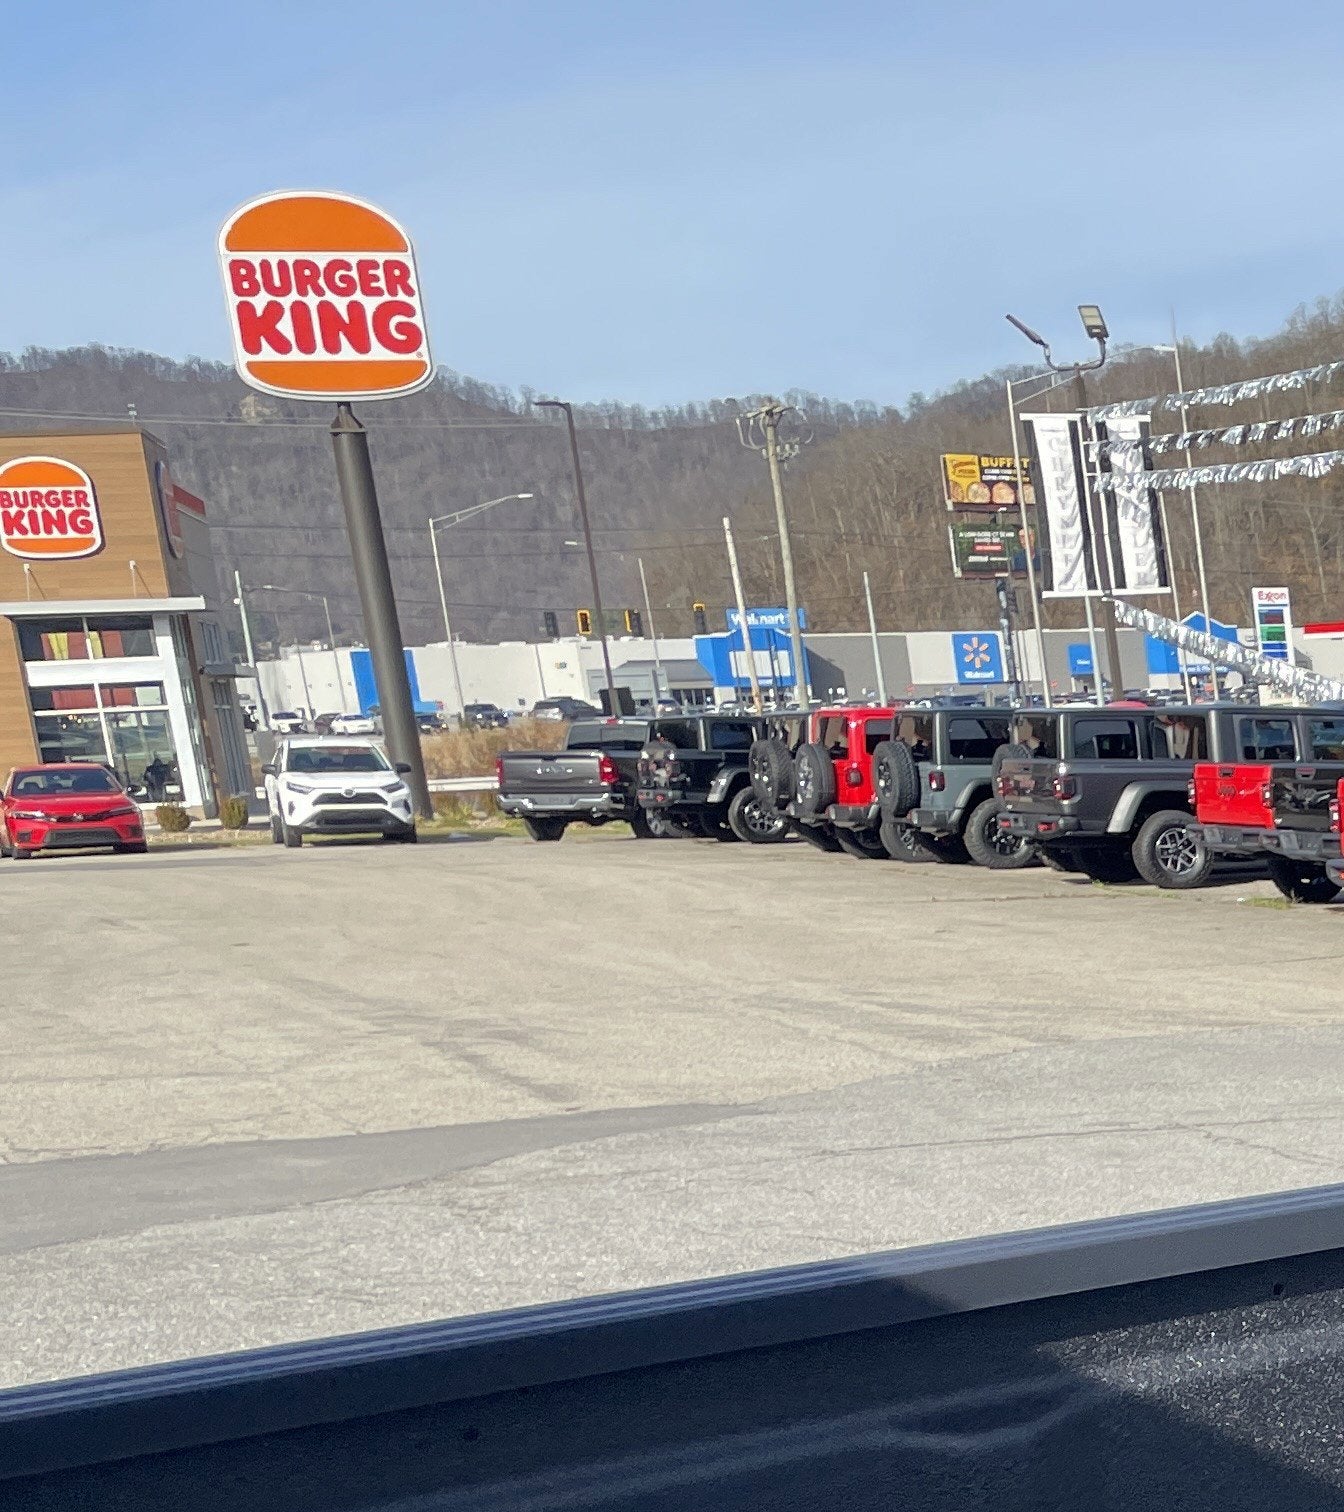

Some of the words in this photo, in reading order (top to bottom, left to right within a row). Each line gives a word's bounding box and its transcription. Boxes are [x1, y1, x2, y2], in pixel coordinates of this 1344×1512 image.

[229, 258, 416, 298] BURGER
[236, 300, 423, 355] KING
[980, 456, 1030, 469] BUFFT
[0, 490, 91, 509] BURGER
[1, 509, 95, 536] KING
[1257, 590, 1287, 603] Exxon
